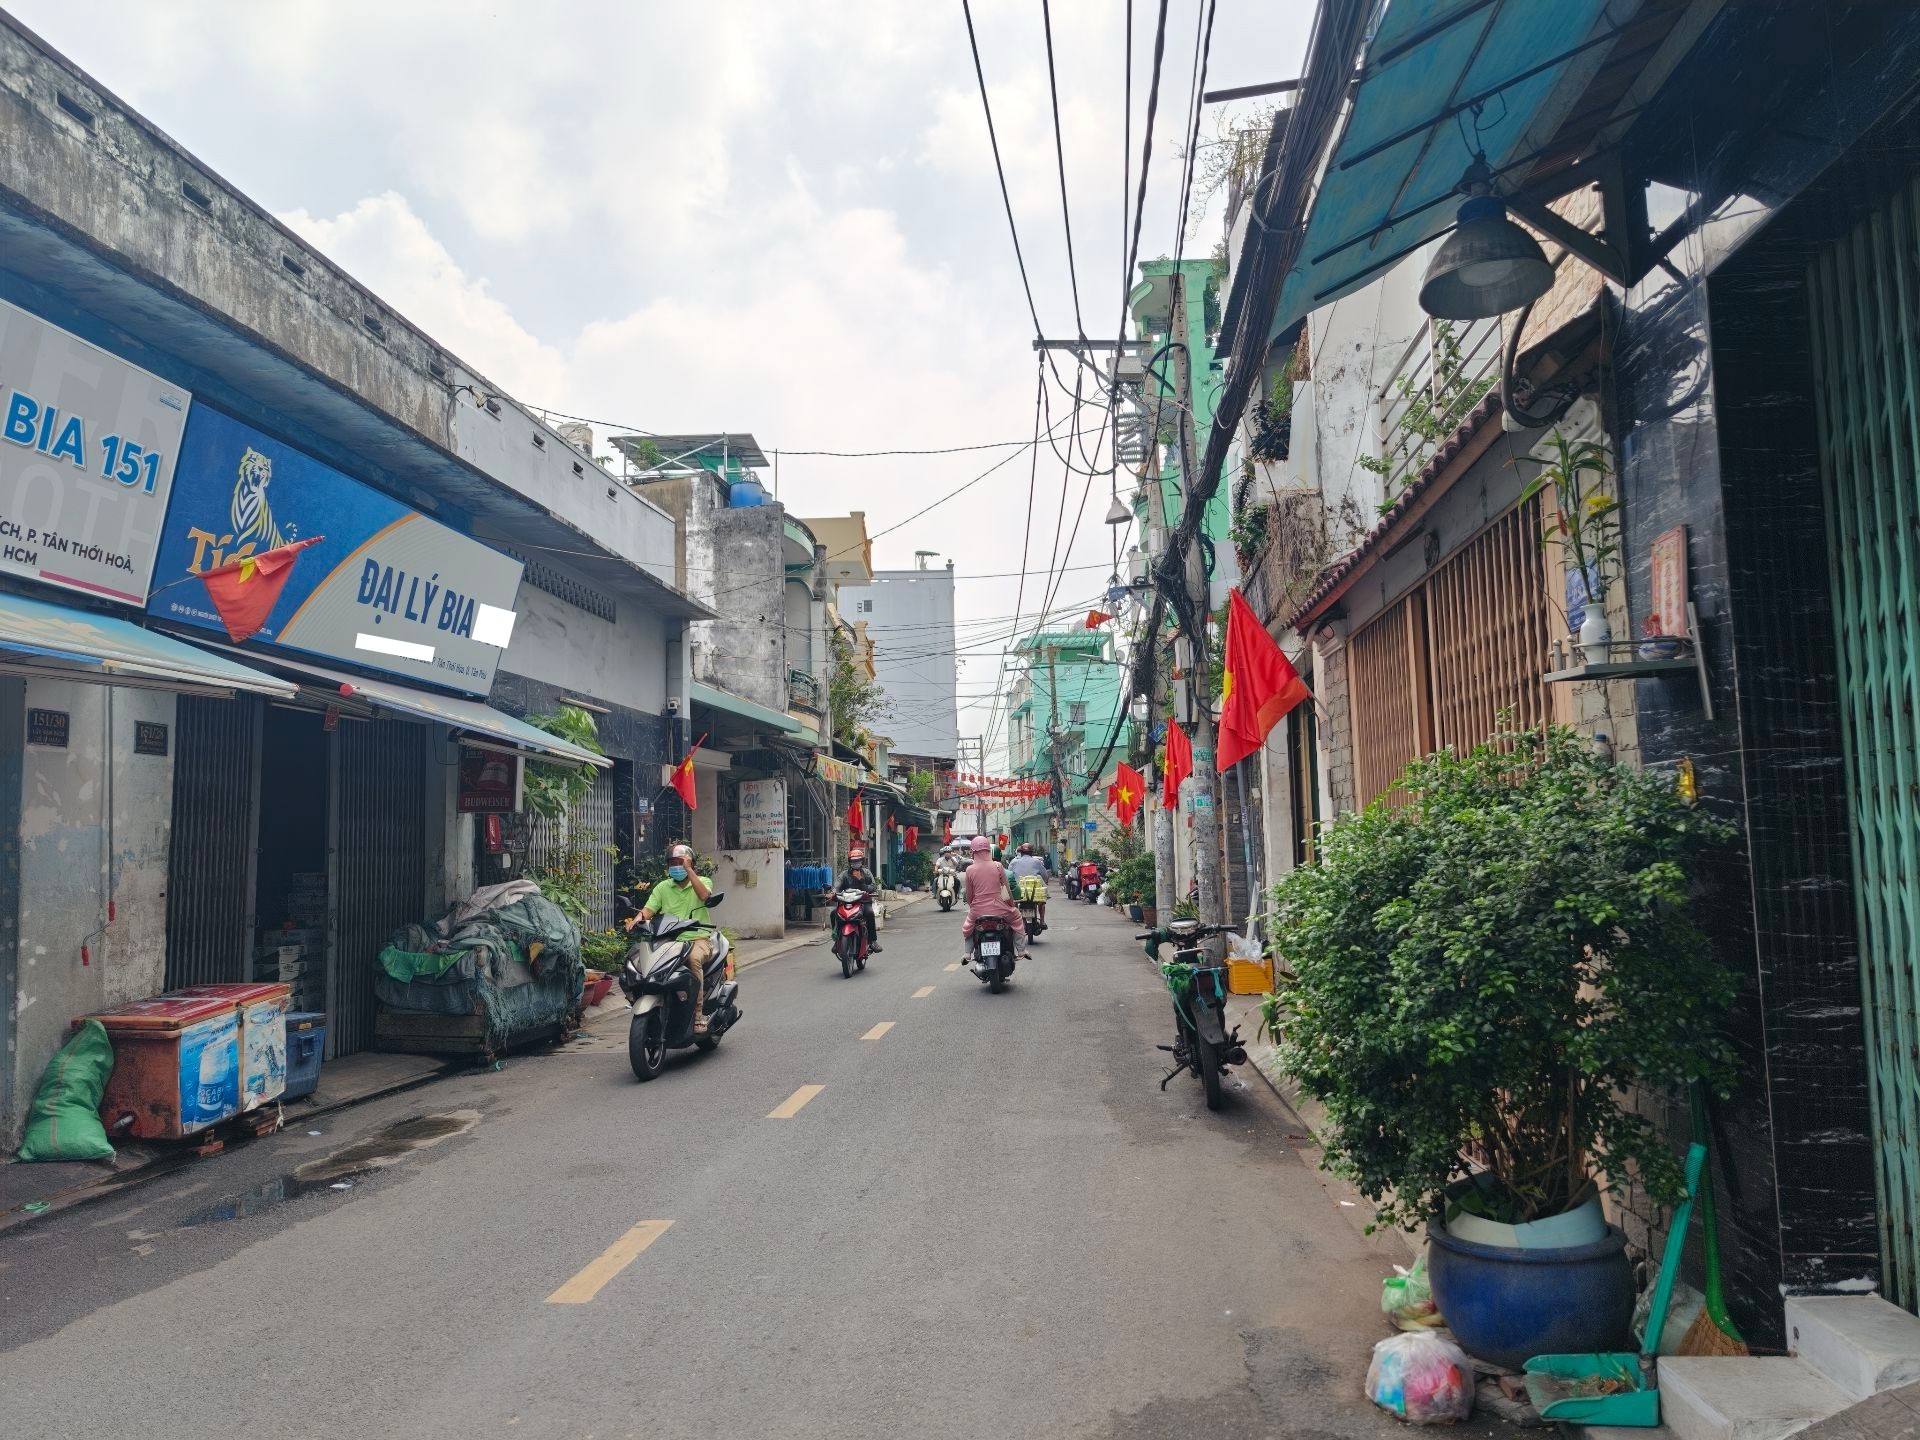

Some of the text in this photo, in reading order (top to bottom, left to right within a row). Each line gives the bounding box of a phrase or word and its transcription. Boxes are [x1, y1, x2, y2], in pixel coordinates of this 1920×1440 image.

[1, 389, 162, 497] BIA 151
[3, 544, 38, 566] HCM
[27, 528, 37, 544] P.
[42, 531, 69, 552] TÂN
[72, 541, 104, 563] THỚI
[104, 552, 134, 574] HOÀ,
[356, 557, 475, 638] ĐẠI LÝ BIA
[464, 796, 511, 809] BUDWEISER
